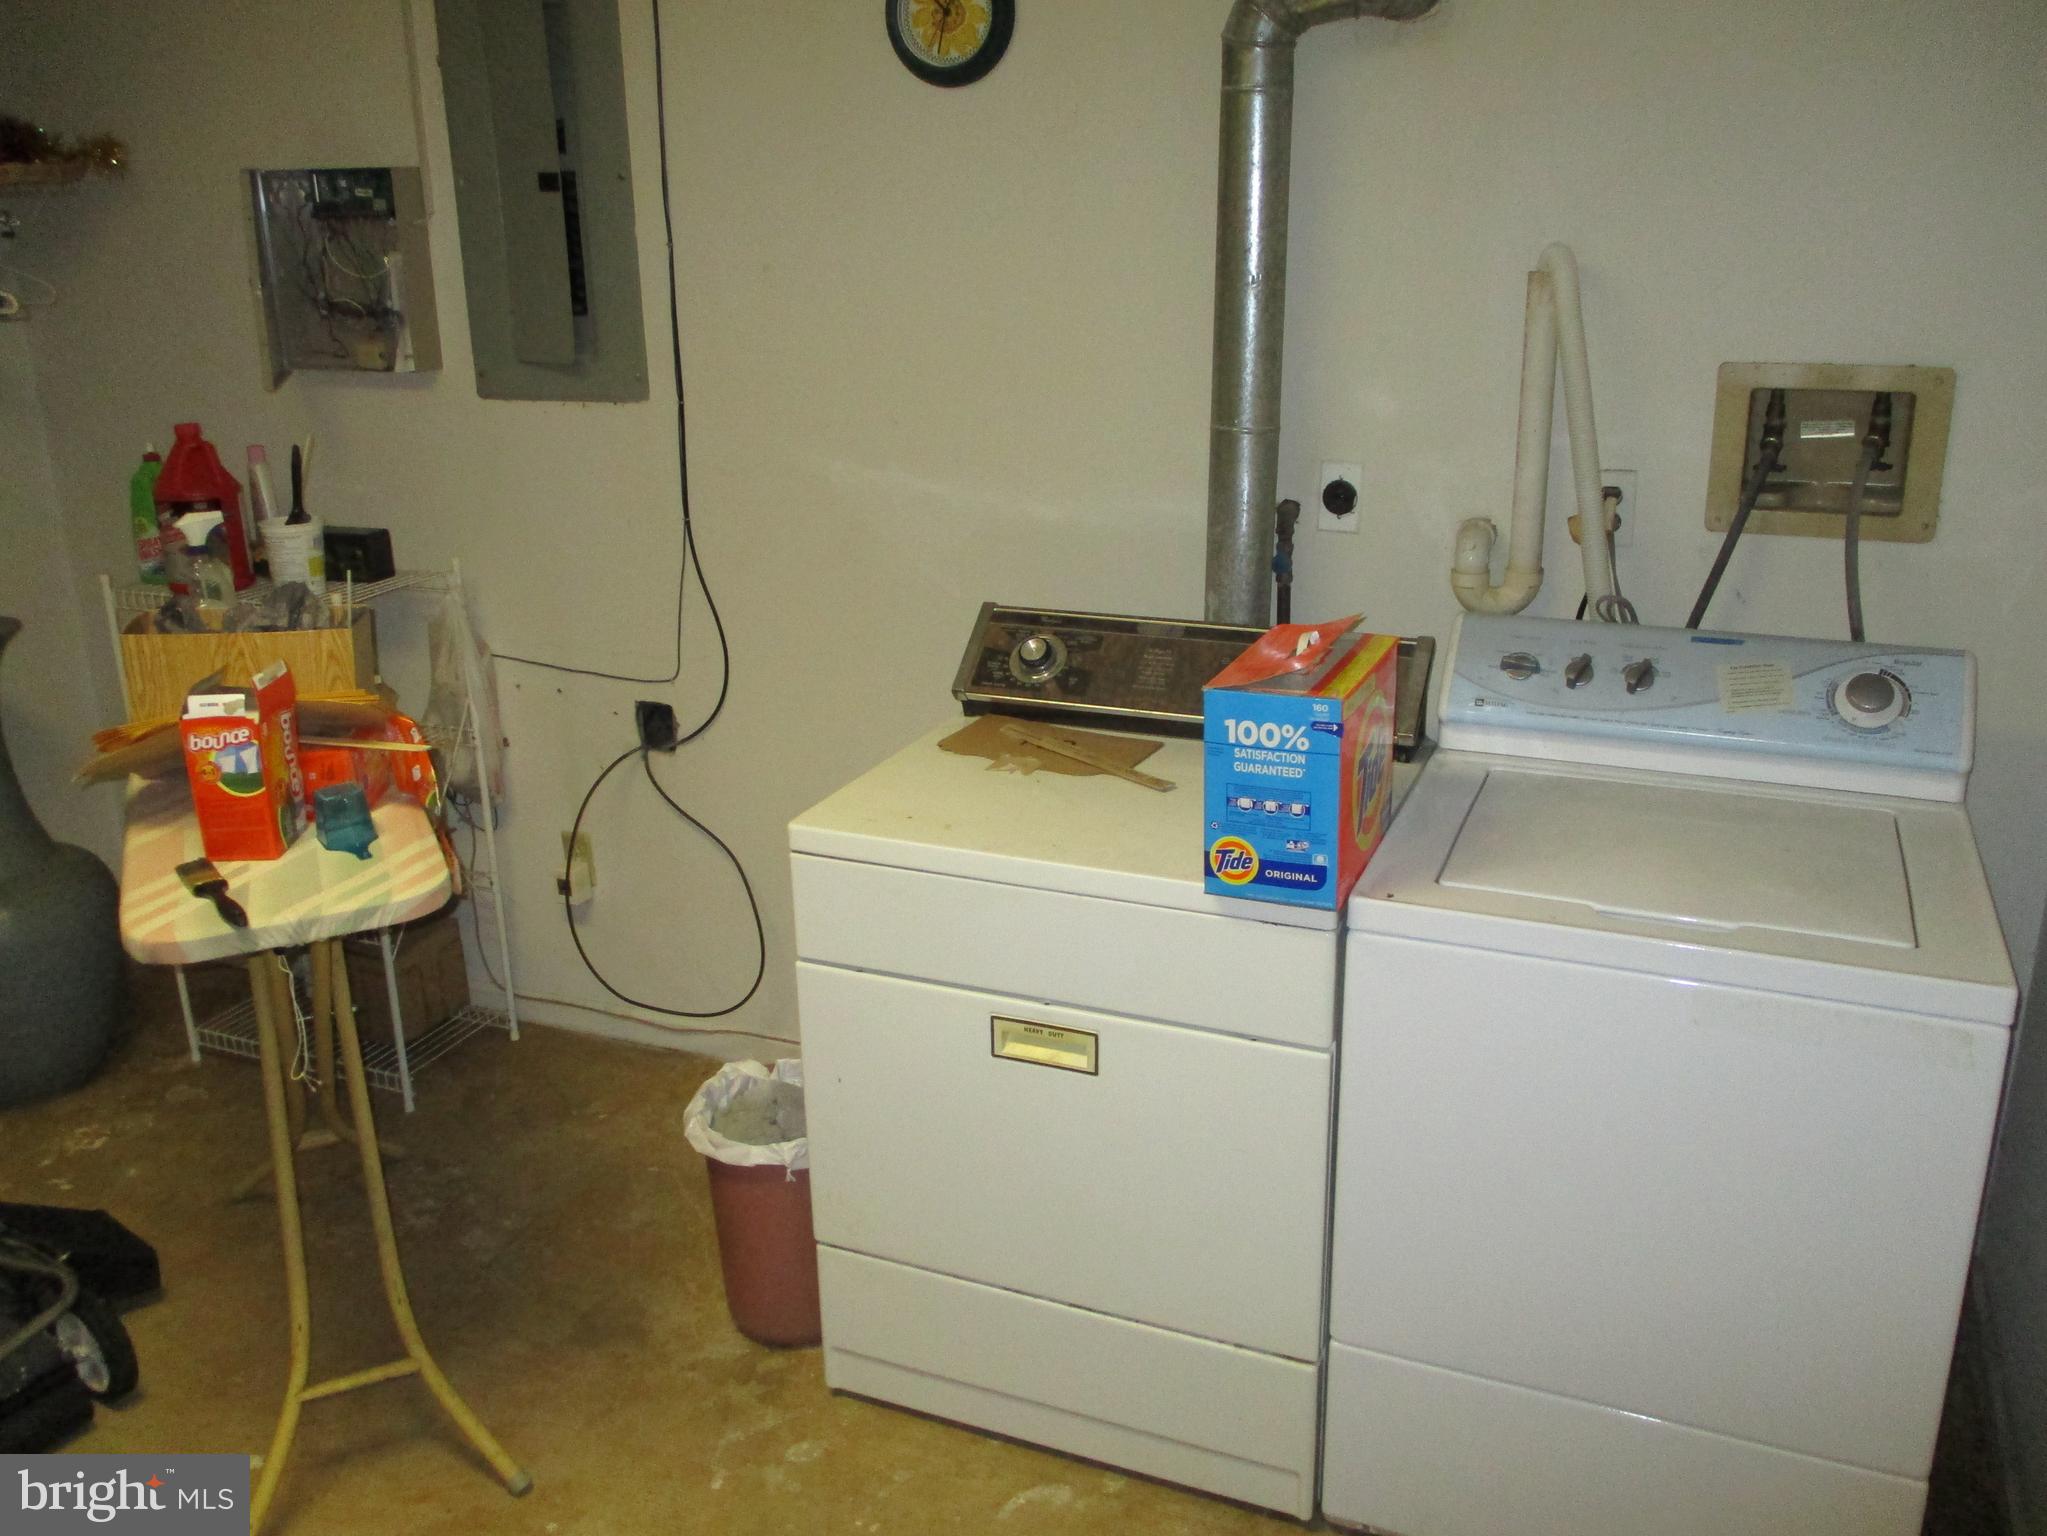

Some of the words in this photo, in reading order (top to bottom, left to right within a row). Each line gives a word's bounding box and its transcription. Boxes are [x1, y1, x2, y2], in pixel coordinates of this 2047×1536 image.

[1312, 703, 1329, 712] 160
[189, 727, 250, 752] bounce
[1223, 718, 1310, 751] 100%
[1233, 747, 1306, 765] SATISFACTION
[1213, 848, 1254, 874] Tide
[1264, 868, 1318, 883] ORIGINAL
[1023, 1026, 1043, 1036] HEAVY
[1047, 1031, 1064, 1039] DUTY
